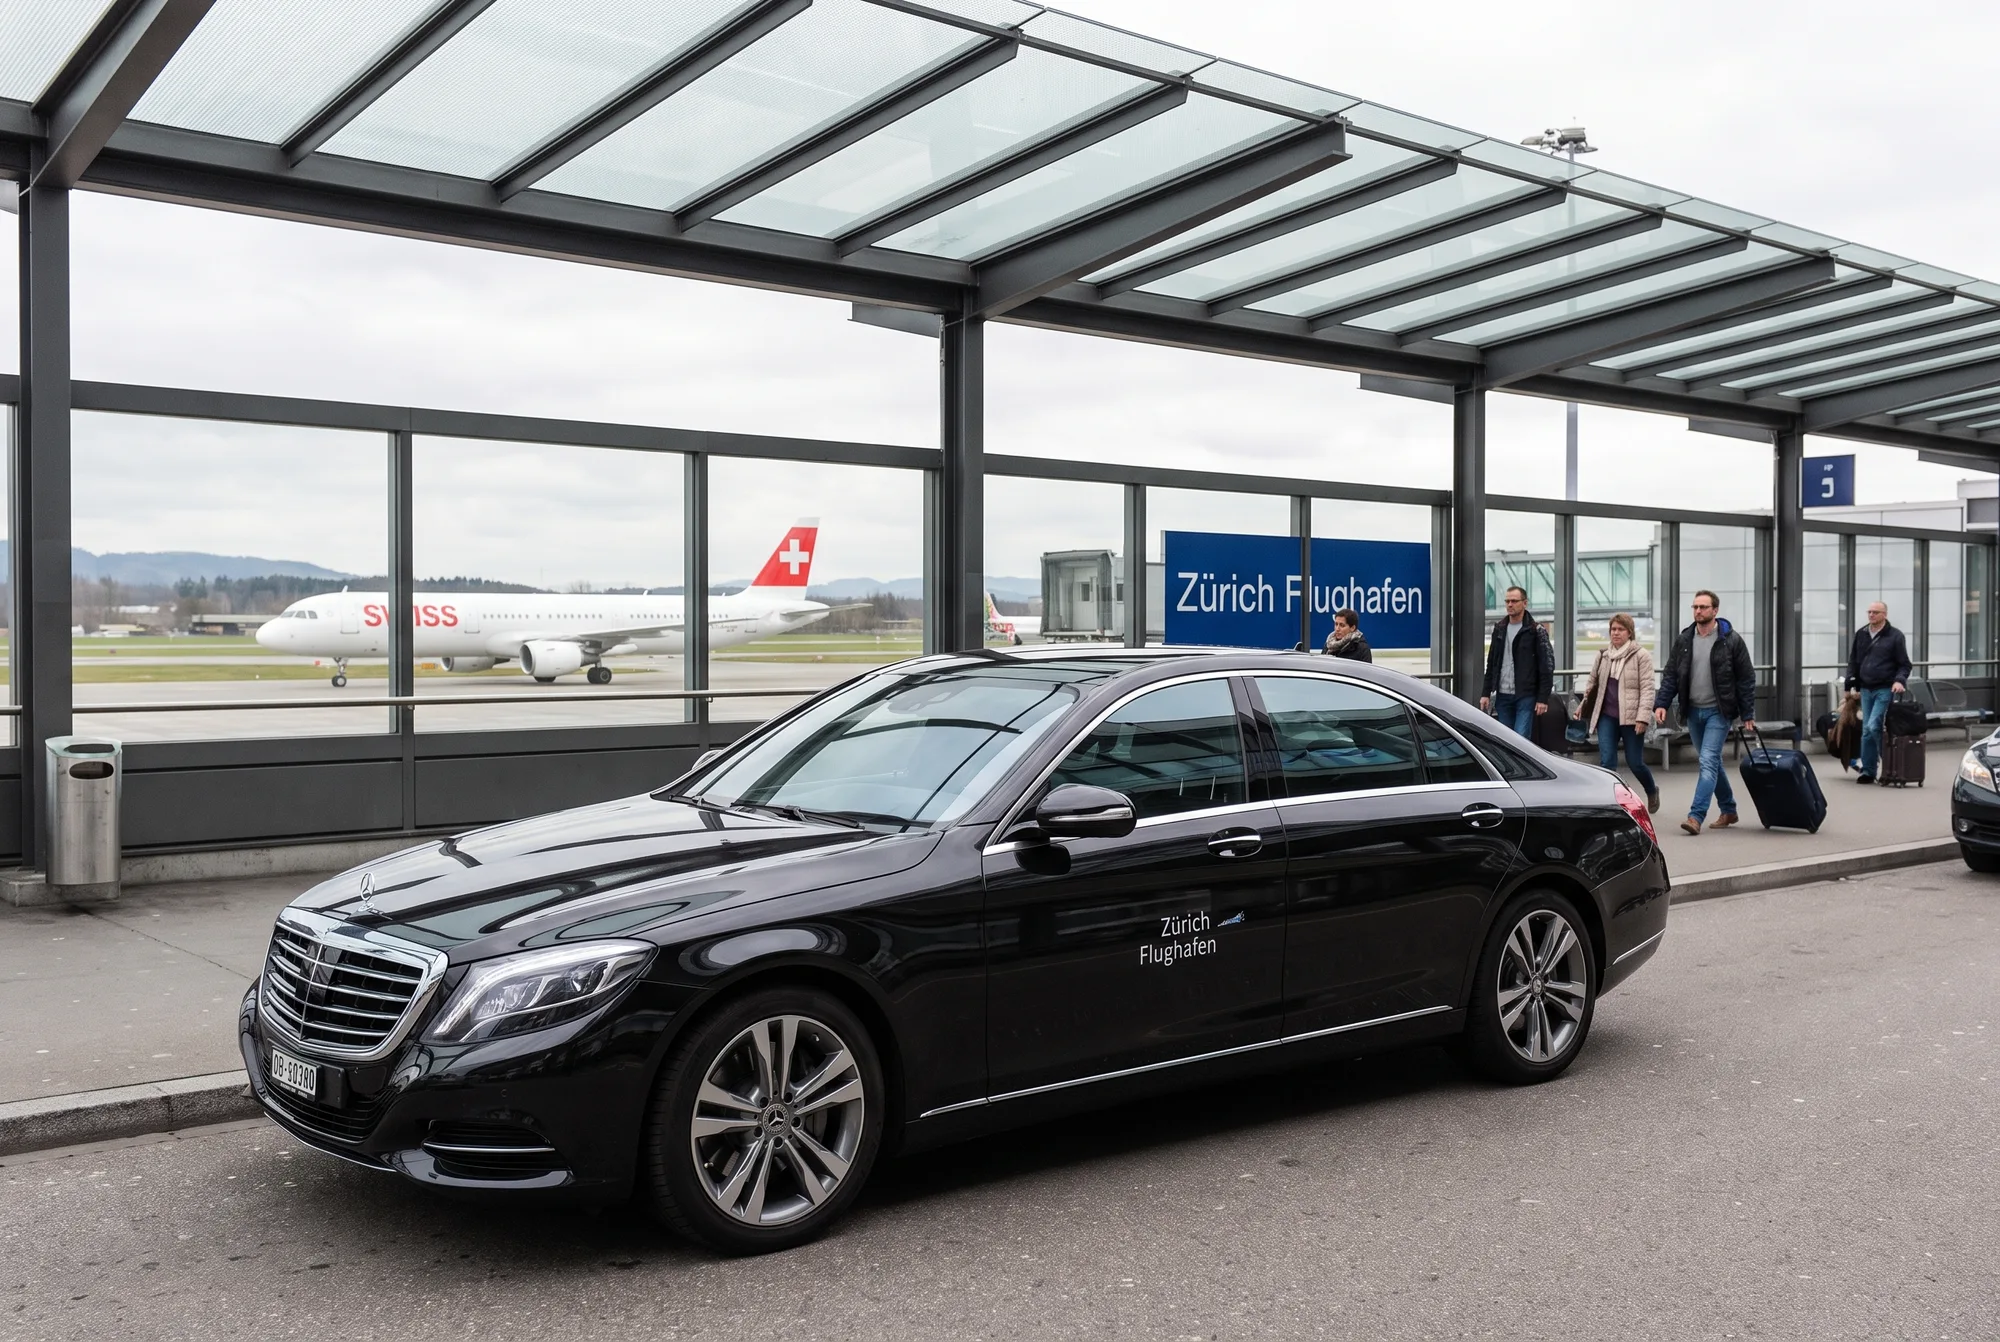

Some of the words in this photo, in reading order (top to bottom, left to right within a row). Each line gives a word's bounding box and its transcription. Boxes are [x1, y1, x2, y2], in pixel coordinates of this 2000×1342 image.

[1176, 572, 1274, 612] Zürich
[1286, 574, 1422, 621] Flughafen
[363, 604, 459, 627] SISS
[1160, 910, 1210, 938] Zürich
[1140, 936, 1217, 966] Flughafen
